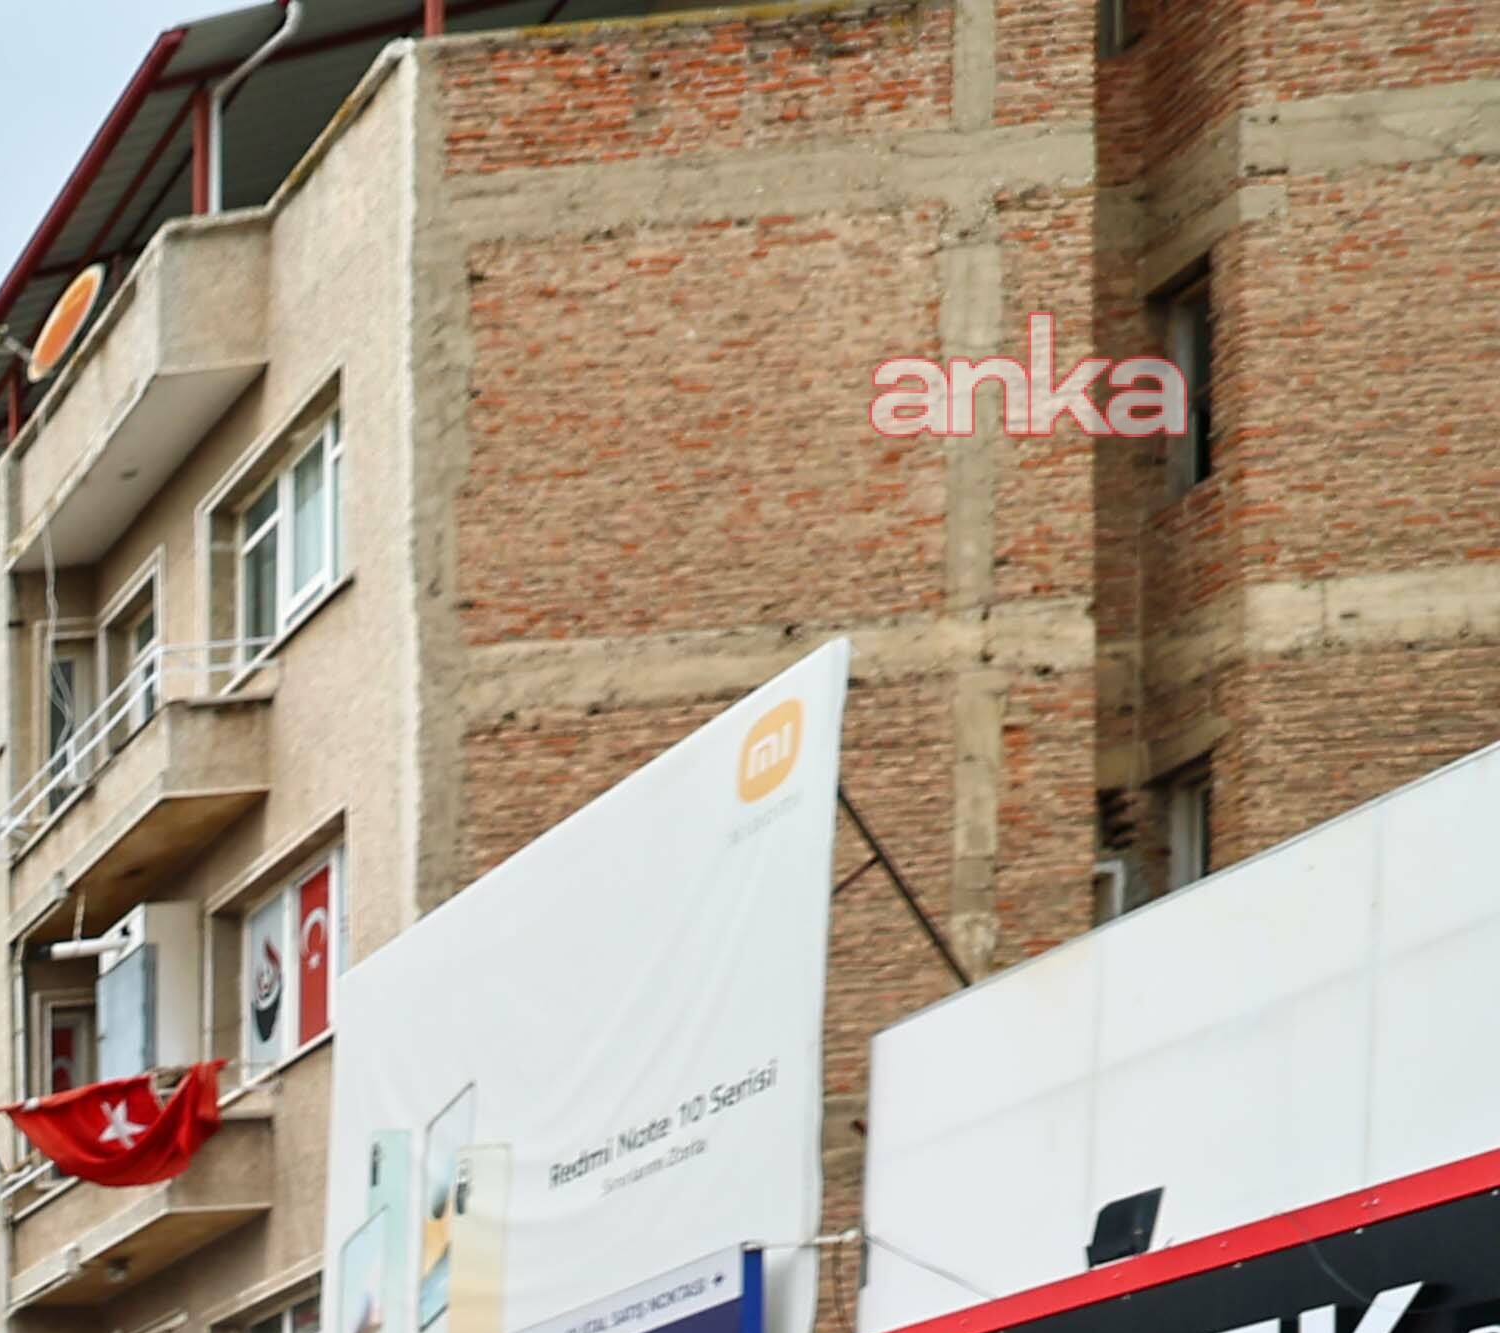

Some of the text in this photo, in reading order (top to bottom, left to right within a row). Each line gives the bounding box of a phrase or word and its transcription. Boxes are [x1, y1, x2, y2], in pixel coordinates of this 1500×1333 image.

[548, 1137, 612, 1190] Redmi
[616, 1115, 672, 1157] Note
[708, 1056, 779, 1114] Serisi
